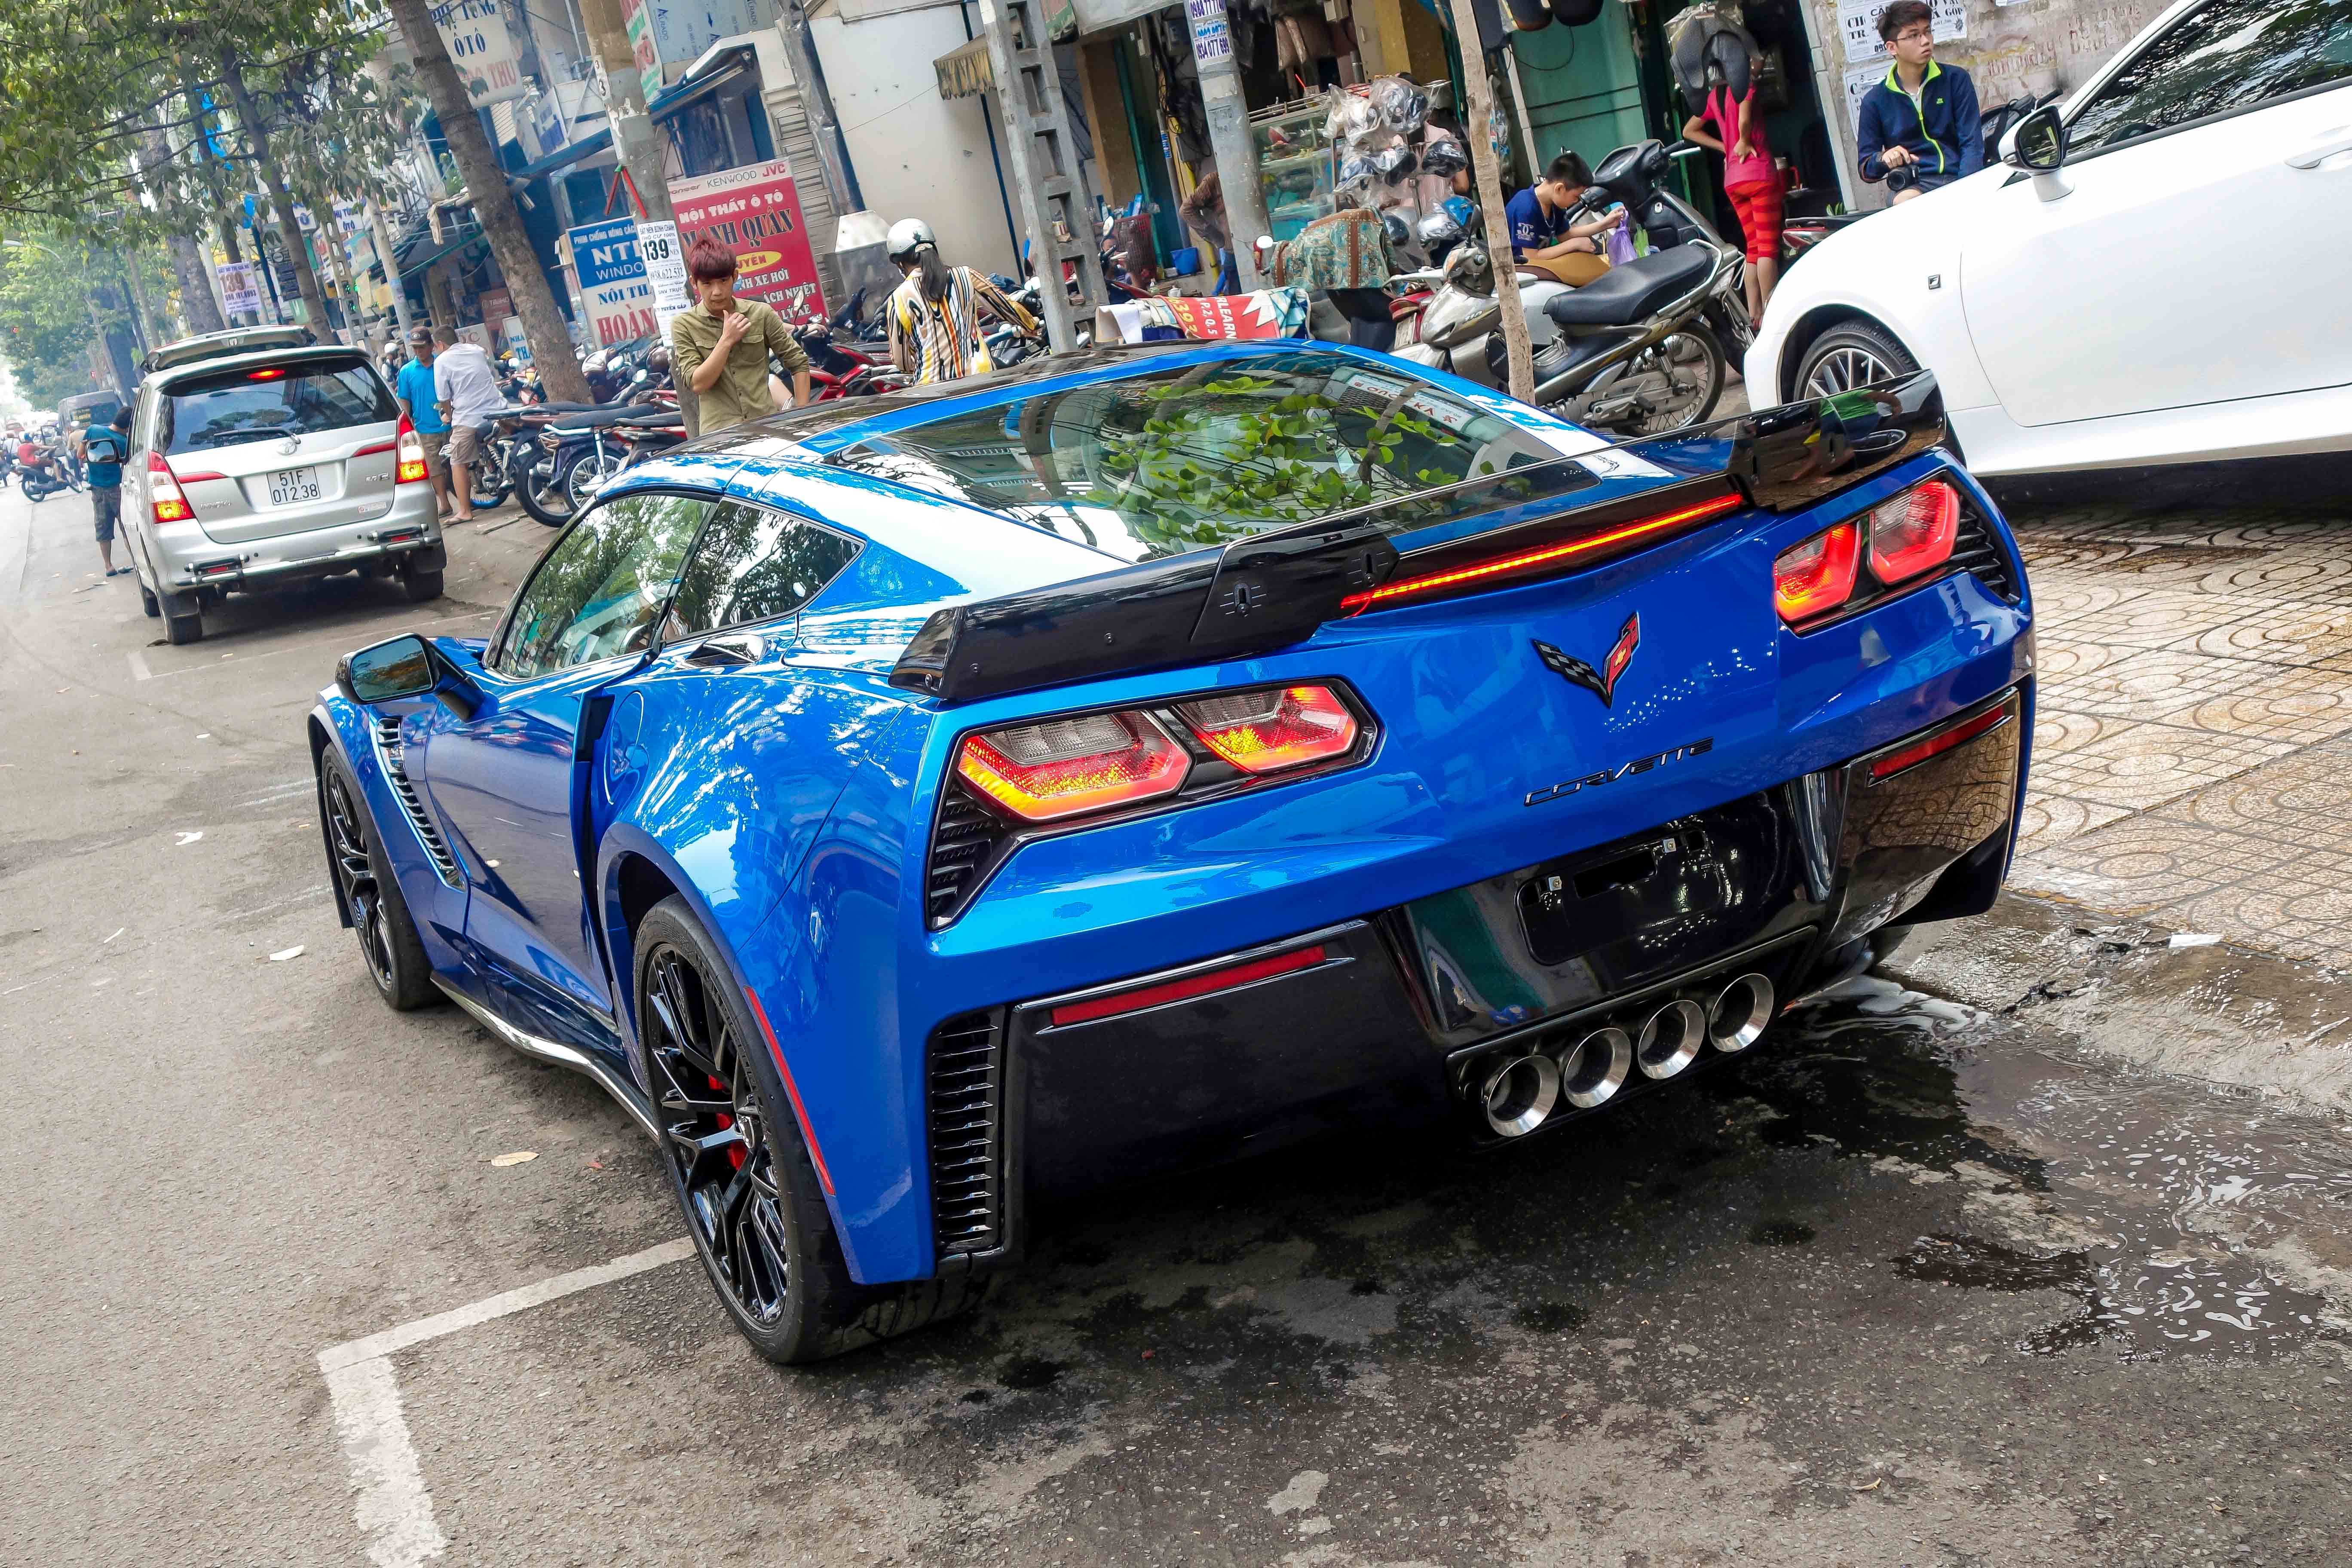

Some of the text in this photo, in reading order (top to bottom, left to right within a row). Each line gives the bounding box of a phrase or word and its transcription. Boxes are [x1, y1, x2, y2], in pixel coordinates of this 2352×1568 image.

[453, 27, 485, 57] ÔTÔ
[668, 163, 786, 195] oneer KENWOOD JVC
[679, 189, 784, 224] NỘI THẤT Ô TÔ
[741, 205, 795, 248] QUÂN
[643, 238, 670, 261] 139
[596, 262, 644, 281] WINDO
[738, 254, 767, 269] UYÊN
[755, 274, 769, 287] XE
[770, 268, 790, 283] HƠI
[597, 287, 625, 305] NỘI
[279, 469, 304, 487] 51F
[272, 483, 319, 503] 012.38
[1524, 736, 1714, 807] CORVETTE
